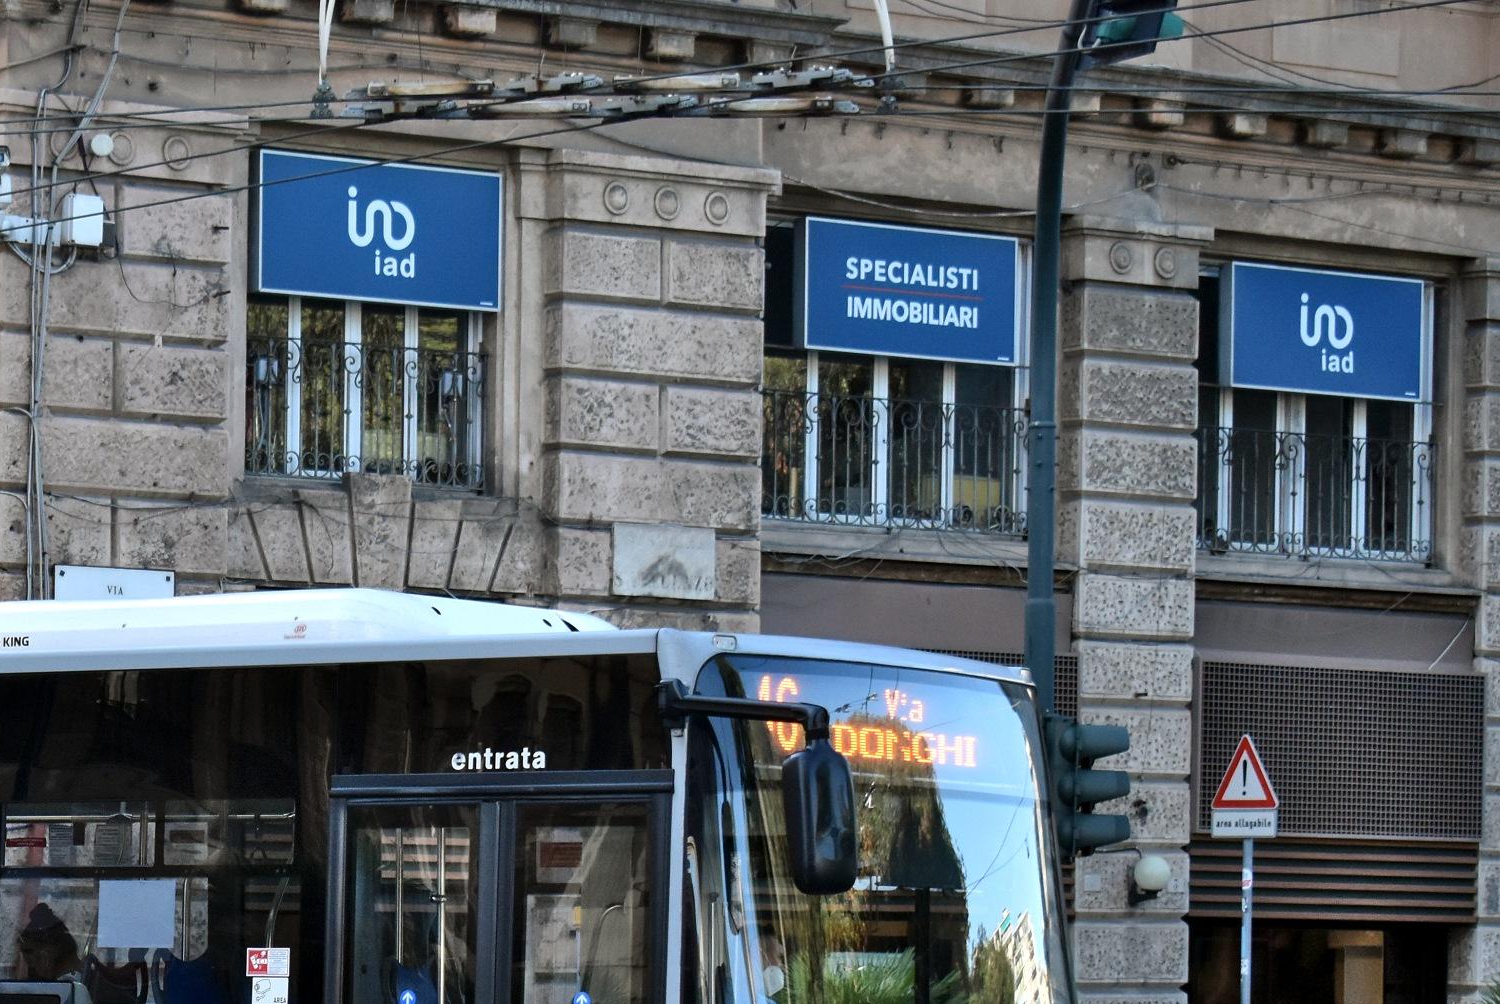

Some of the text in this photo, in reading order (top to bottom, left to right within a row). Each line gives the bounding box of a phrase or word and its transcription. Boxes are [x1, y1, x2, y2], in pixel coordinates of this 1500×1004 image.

[374, 248, 415, 279] iad
[845, 256, 979, 291] SPECIALISTI
[847, 296, 978, 329] IMMOBILIARI
[1321, 347, 1354, 374] iad
[107, 585, 124, 596] VIA
[3, 636, 30, 648] KING
[451, 747, 547, 771] entrata
[832, 724, 977, 768] DONGHI
[1216, 818, 1272, 830] area allagabile
